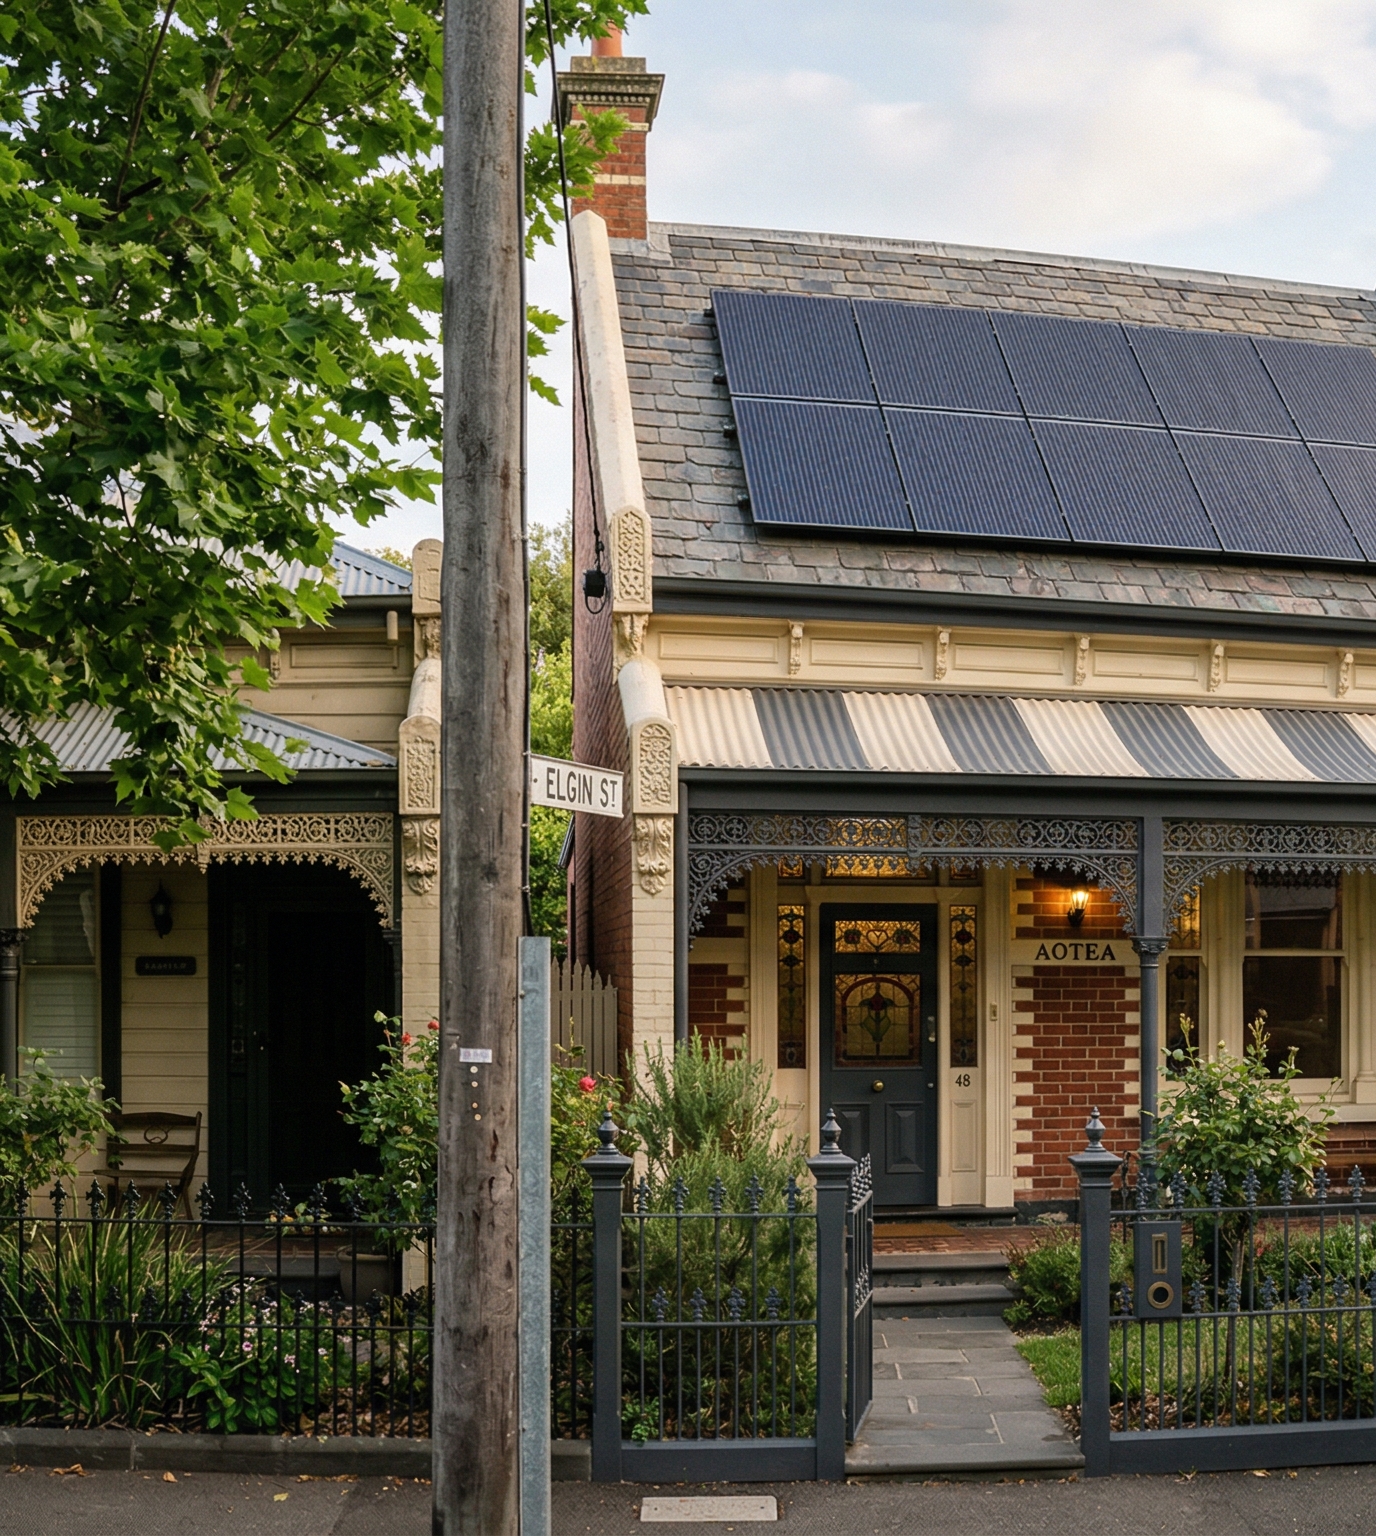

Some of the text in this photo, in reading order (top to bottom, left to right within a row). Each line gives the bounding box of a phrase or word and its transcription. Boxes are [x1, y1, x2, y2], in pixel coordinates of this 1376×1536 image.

[546, 766, 593, 806] ELGIN
[1034, 942, 1117, 961] AOTEA
[955, 1073, 971, 1087] 48
